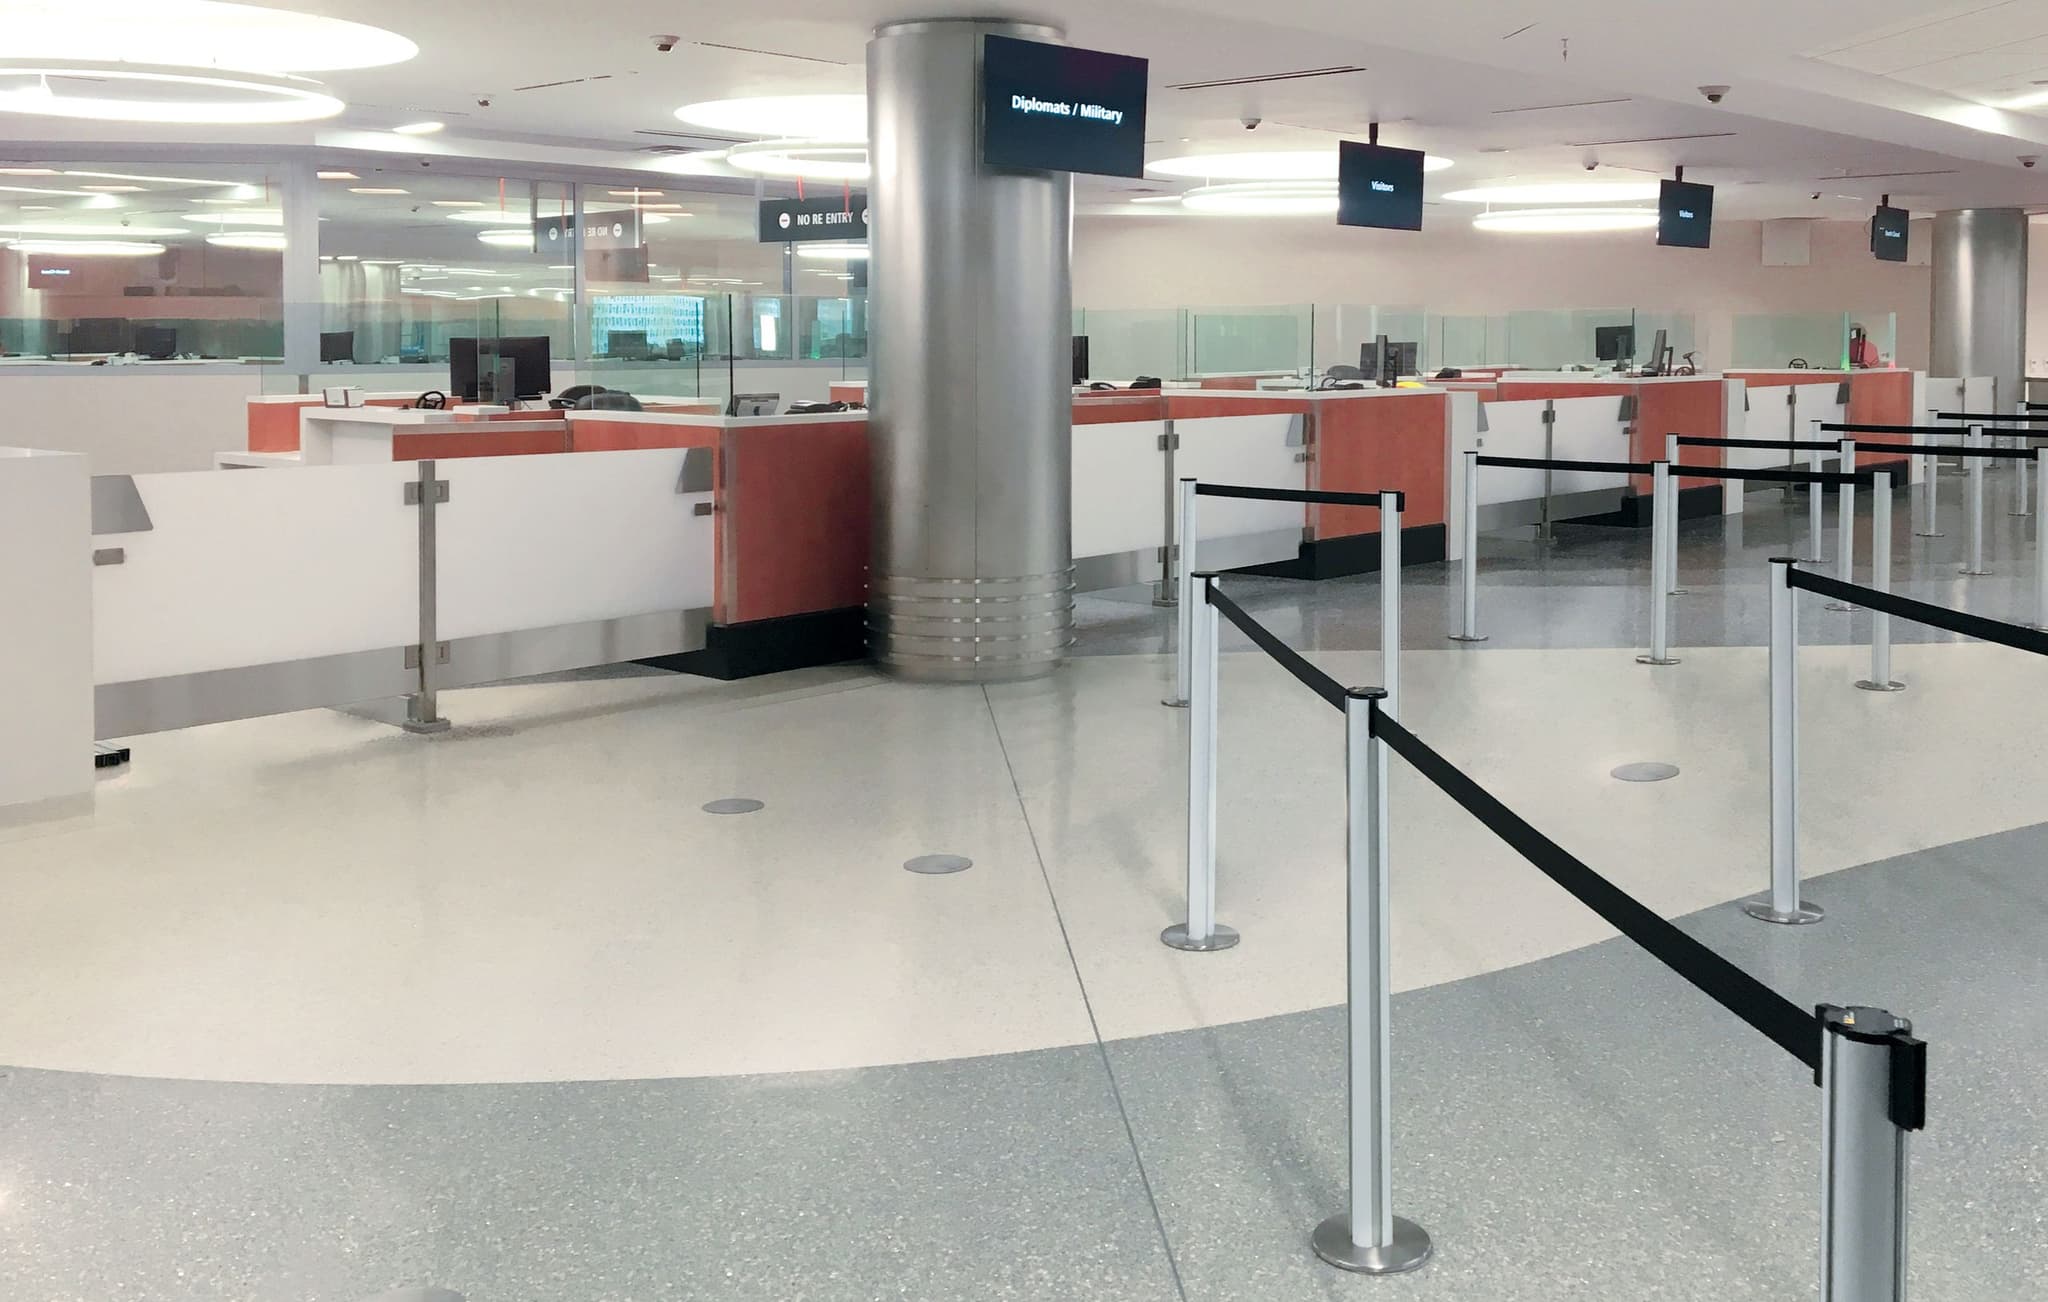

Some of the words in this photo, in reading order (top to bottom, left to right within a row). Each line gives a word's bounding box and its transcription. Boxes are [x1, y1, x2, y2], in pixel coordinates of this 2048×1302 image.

[1011, 95, 1071, 115] Diplomats
[1072, 103, 1078, 116] /
[1080, 103, 1123, 124] Military
[797, 214, 810, 226] NO
[812, 213, 823, 225] RE
[826, 212, 854, 224] ENTRY
